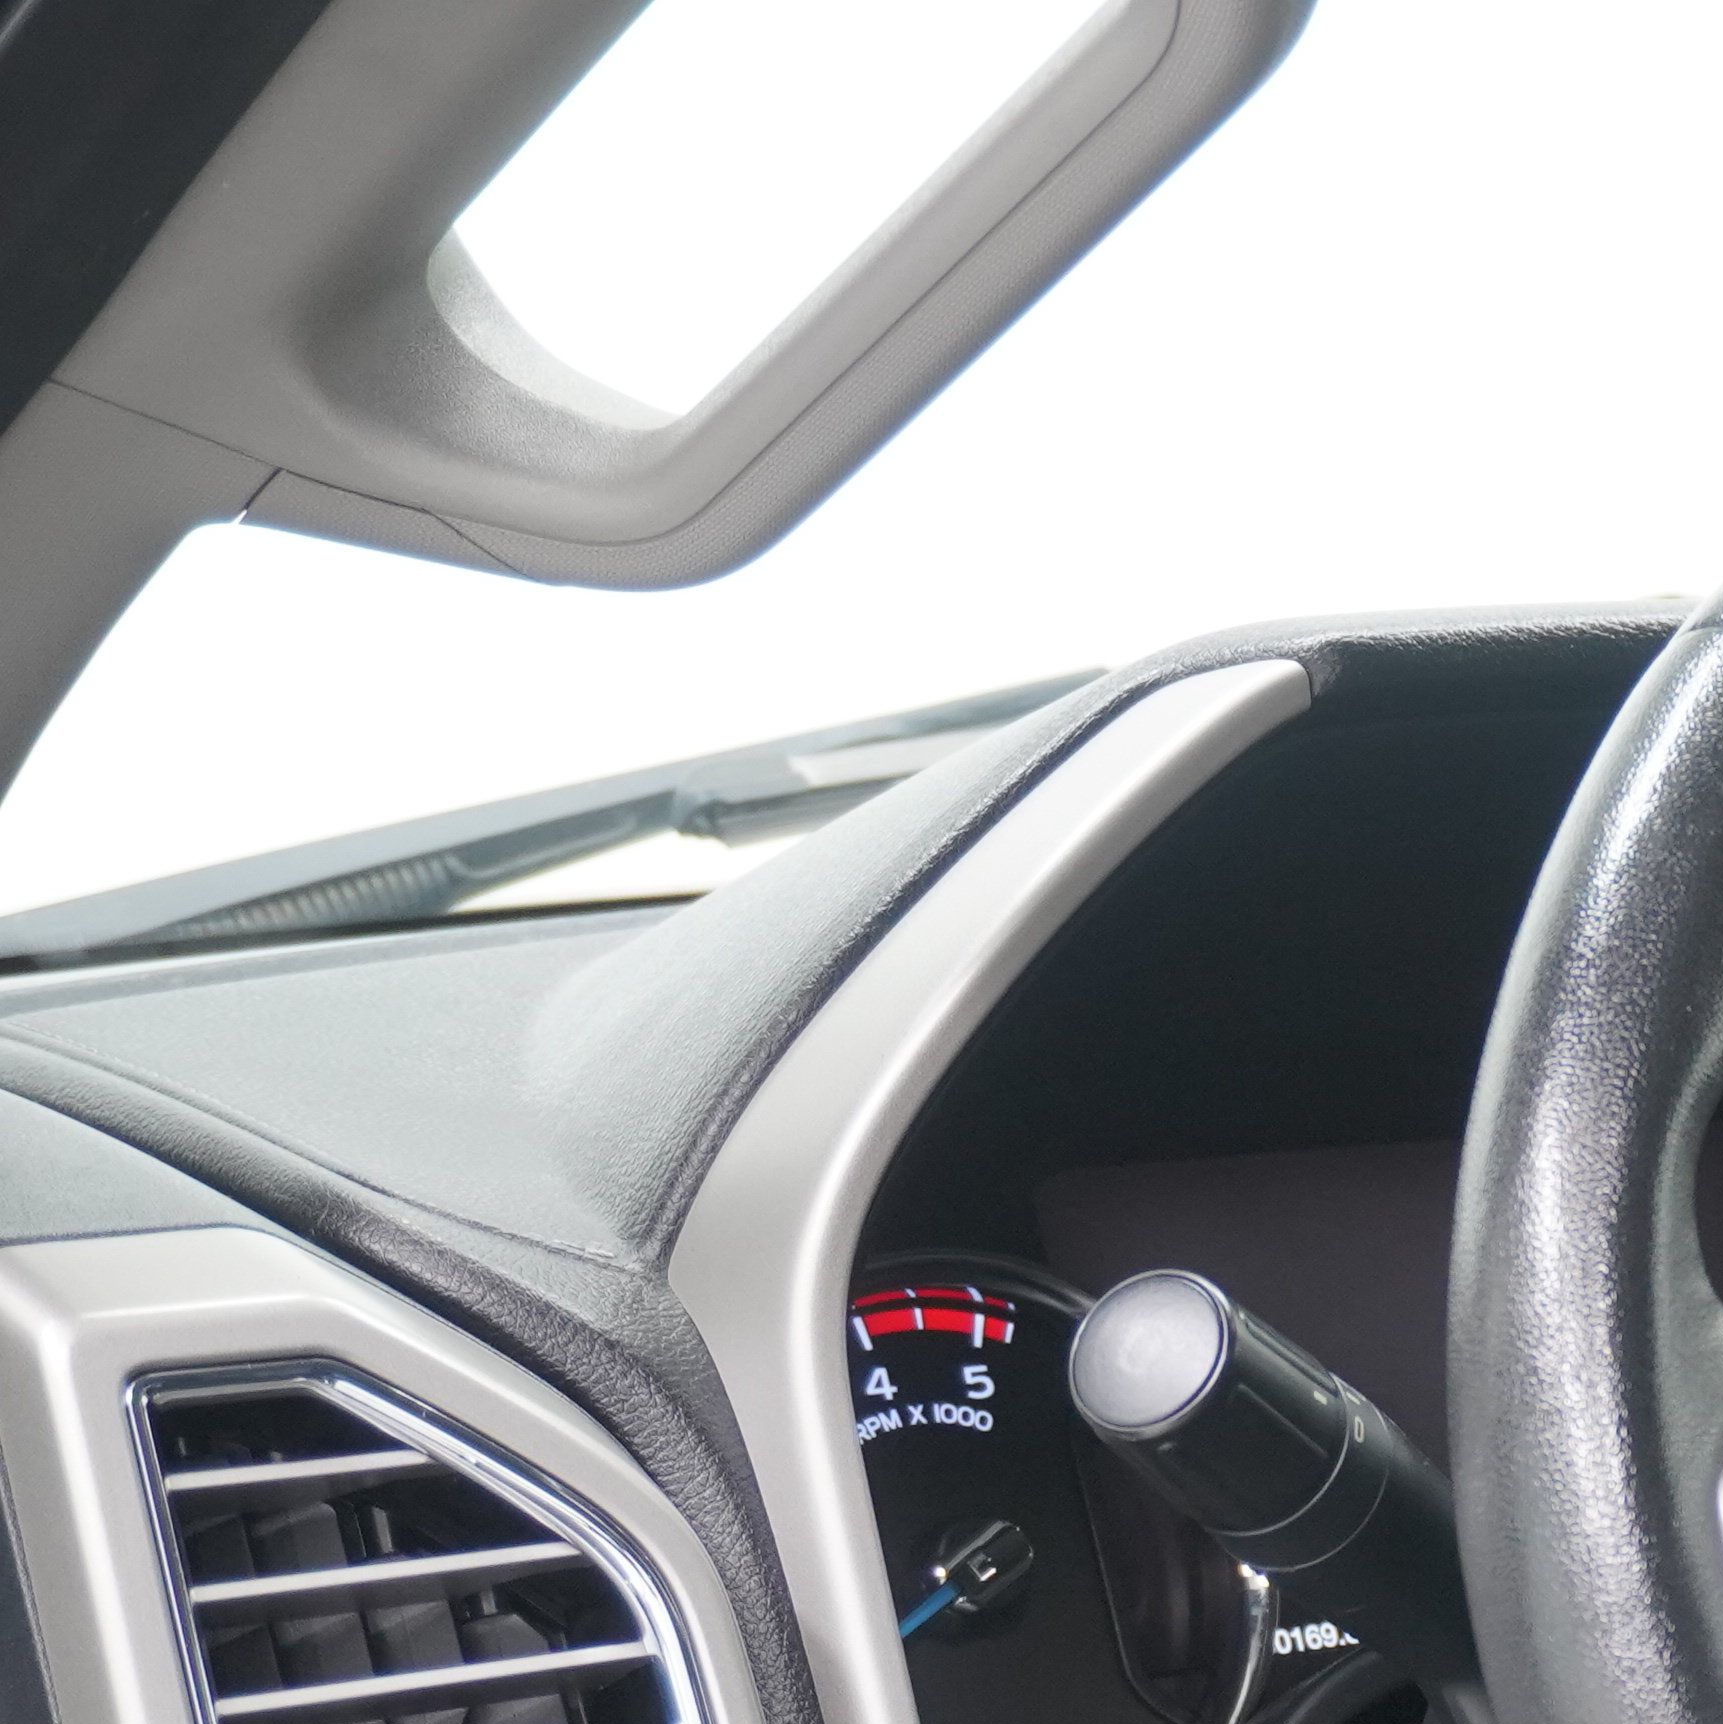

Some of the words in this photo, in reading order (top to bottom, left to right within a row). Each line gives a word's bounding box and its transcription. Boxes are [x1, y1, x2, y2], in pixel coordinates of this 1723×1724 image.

[866, 1366, 899, 1401] 4
[962, 1364, 996, 1400] 5
[856, 1408, 903, 1445] RPM
[908, 1403, 928, 1426] X
[933, 1402, 994, 1432] 1000
